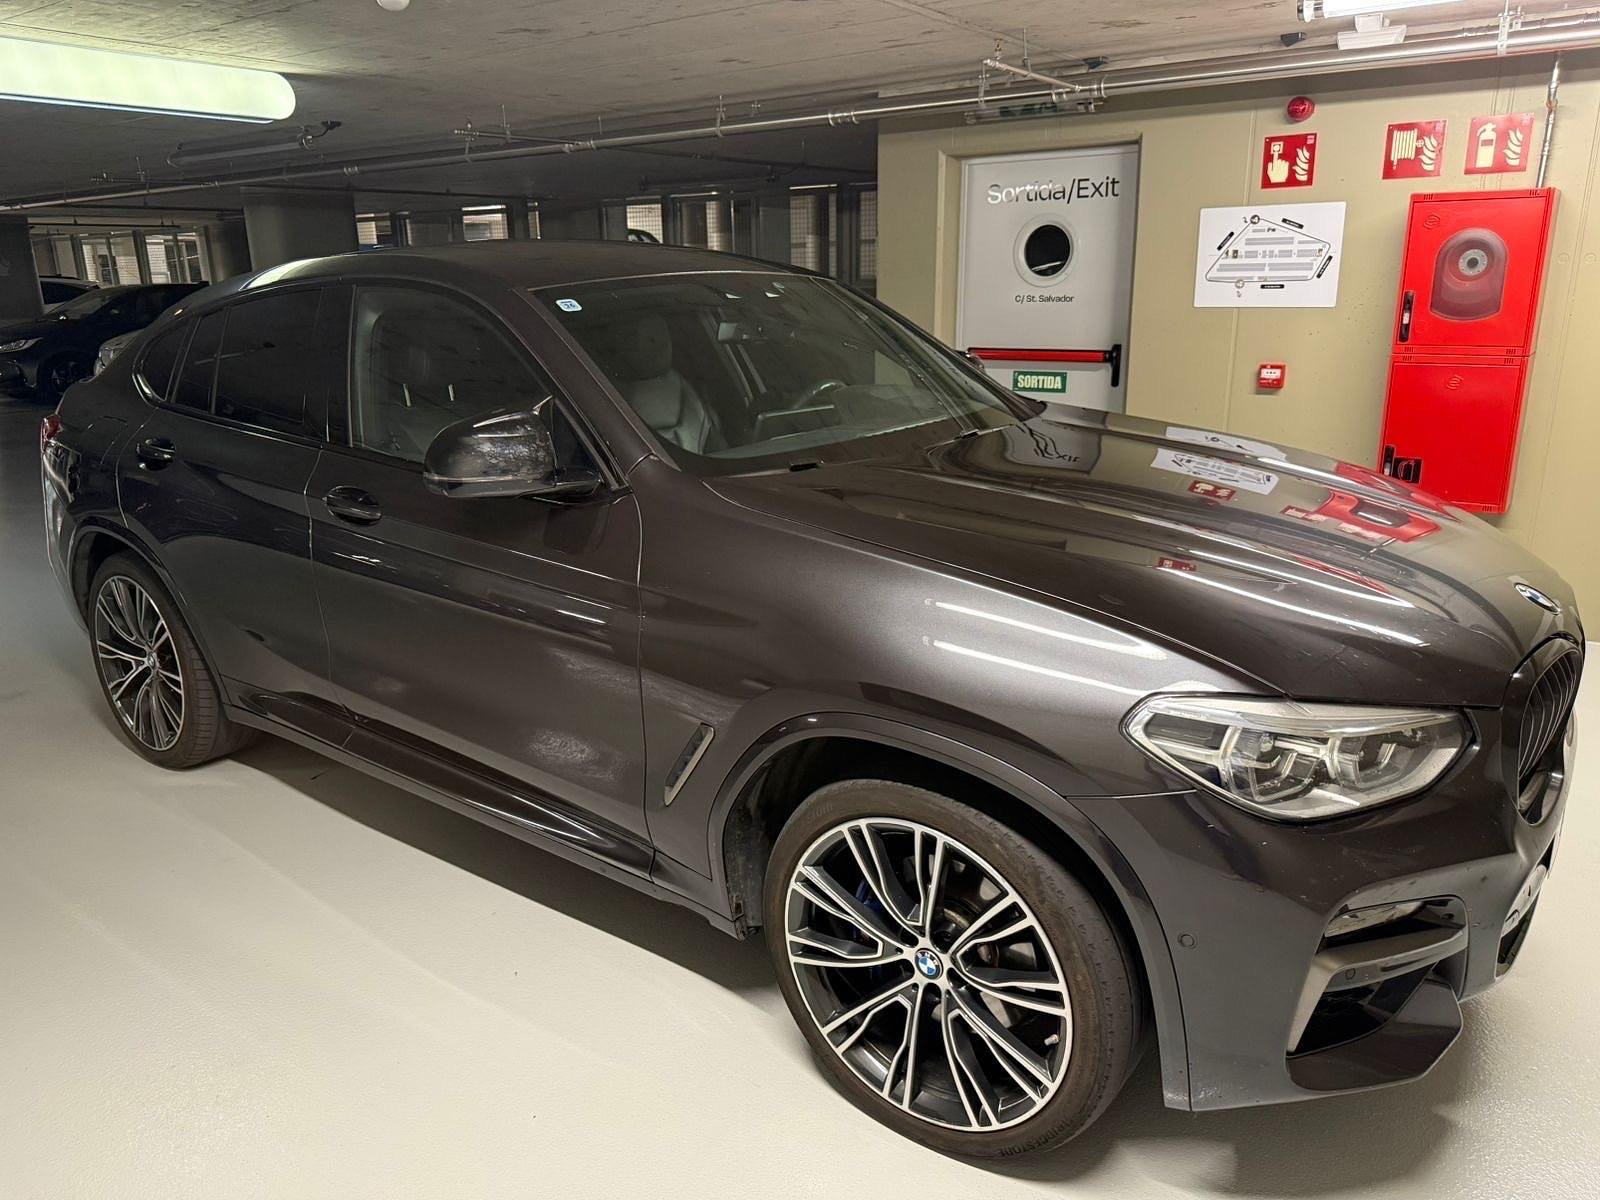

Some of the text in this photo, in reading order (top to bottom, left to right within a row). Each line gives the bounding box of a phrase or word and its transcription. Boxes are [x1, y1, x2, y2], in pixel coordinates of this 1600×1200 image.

[987, 176, 1120, 204] Sortida/Exit
[1015, 295, 1025, 304] C/
[1038, 294, 1074, 303] Salvador
[1017, 375, 1062, 389] SORTIDA
